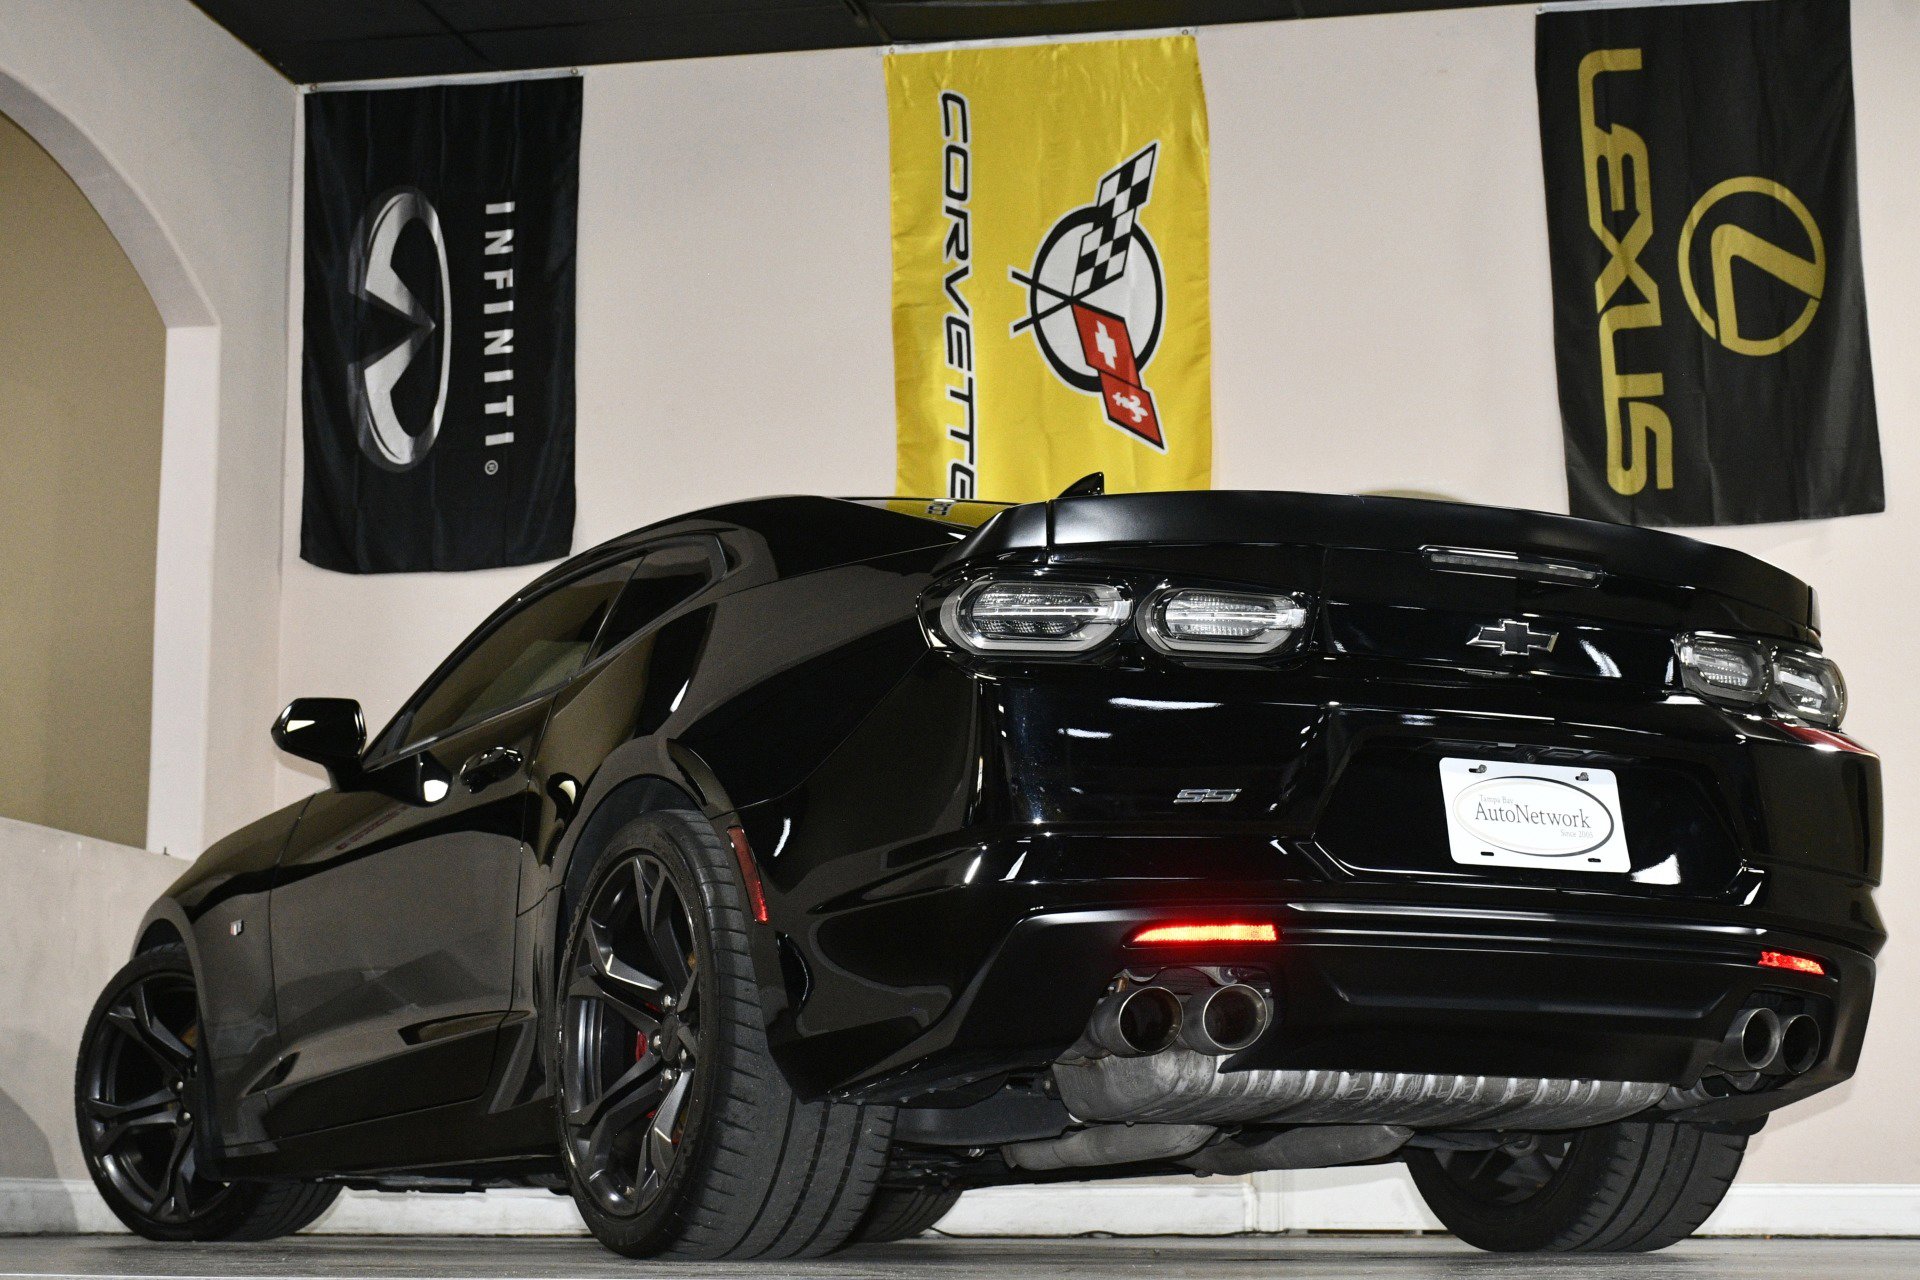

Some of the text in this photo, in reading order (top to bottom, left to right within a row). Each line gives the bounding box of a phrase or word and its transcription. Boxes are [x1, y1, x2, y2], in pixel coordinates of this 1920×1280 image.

[484, 201, 515, 446] INFINITI
[942, 89, 976, 499] CORVETTE
[1578, 47, 1673, 495] LEXUS
[1173, 788, 1242, 803] SS
[1475, 802, 1591, 828] AutoNetwork
